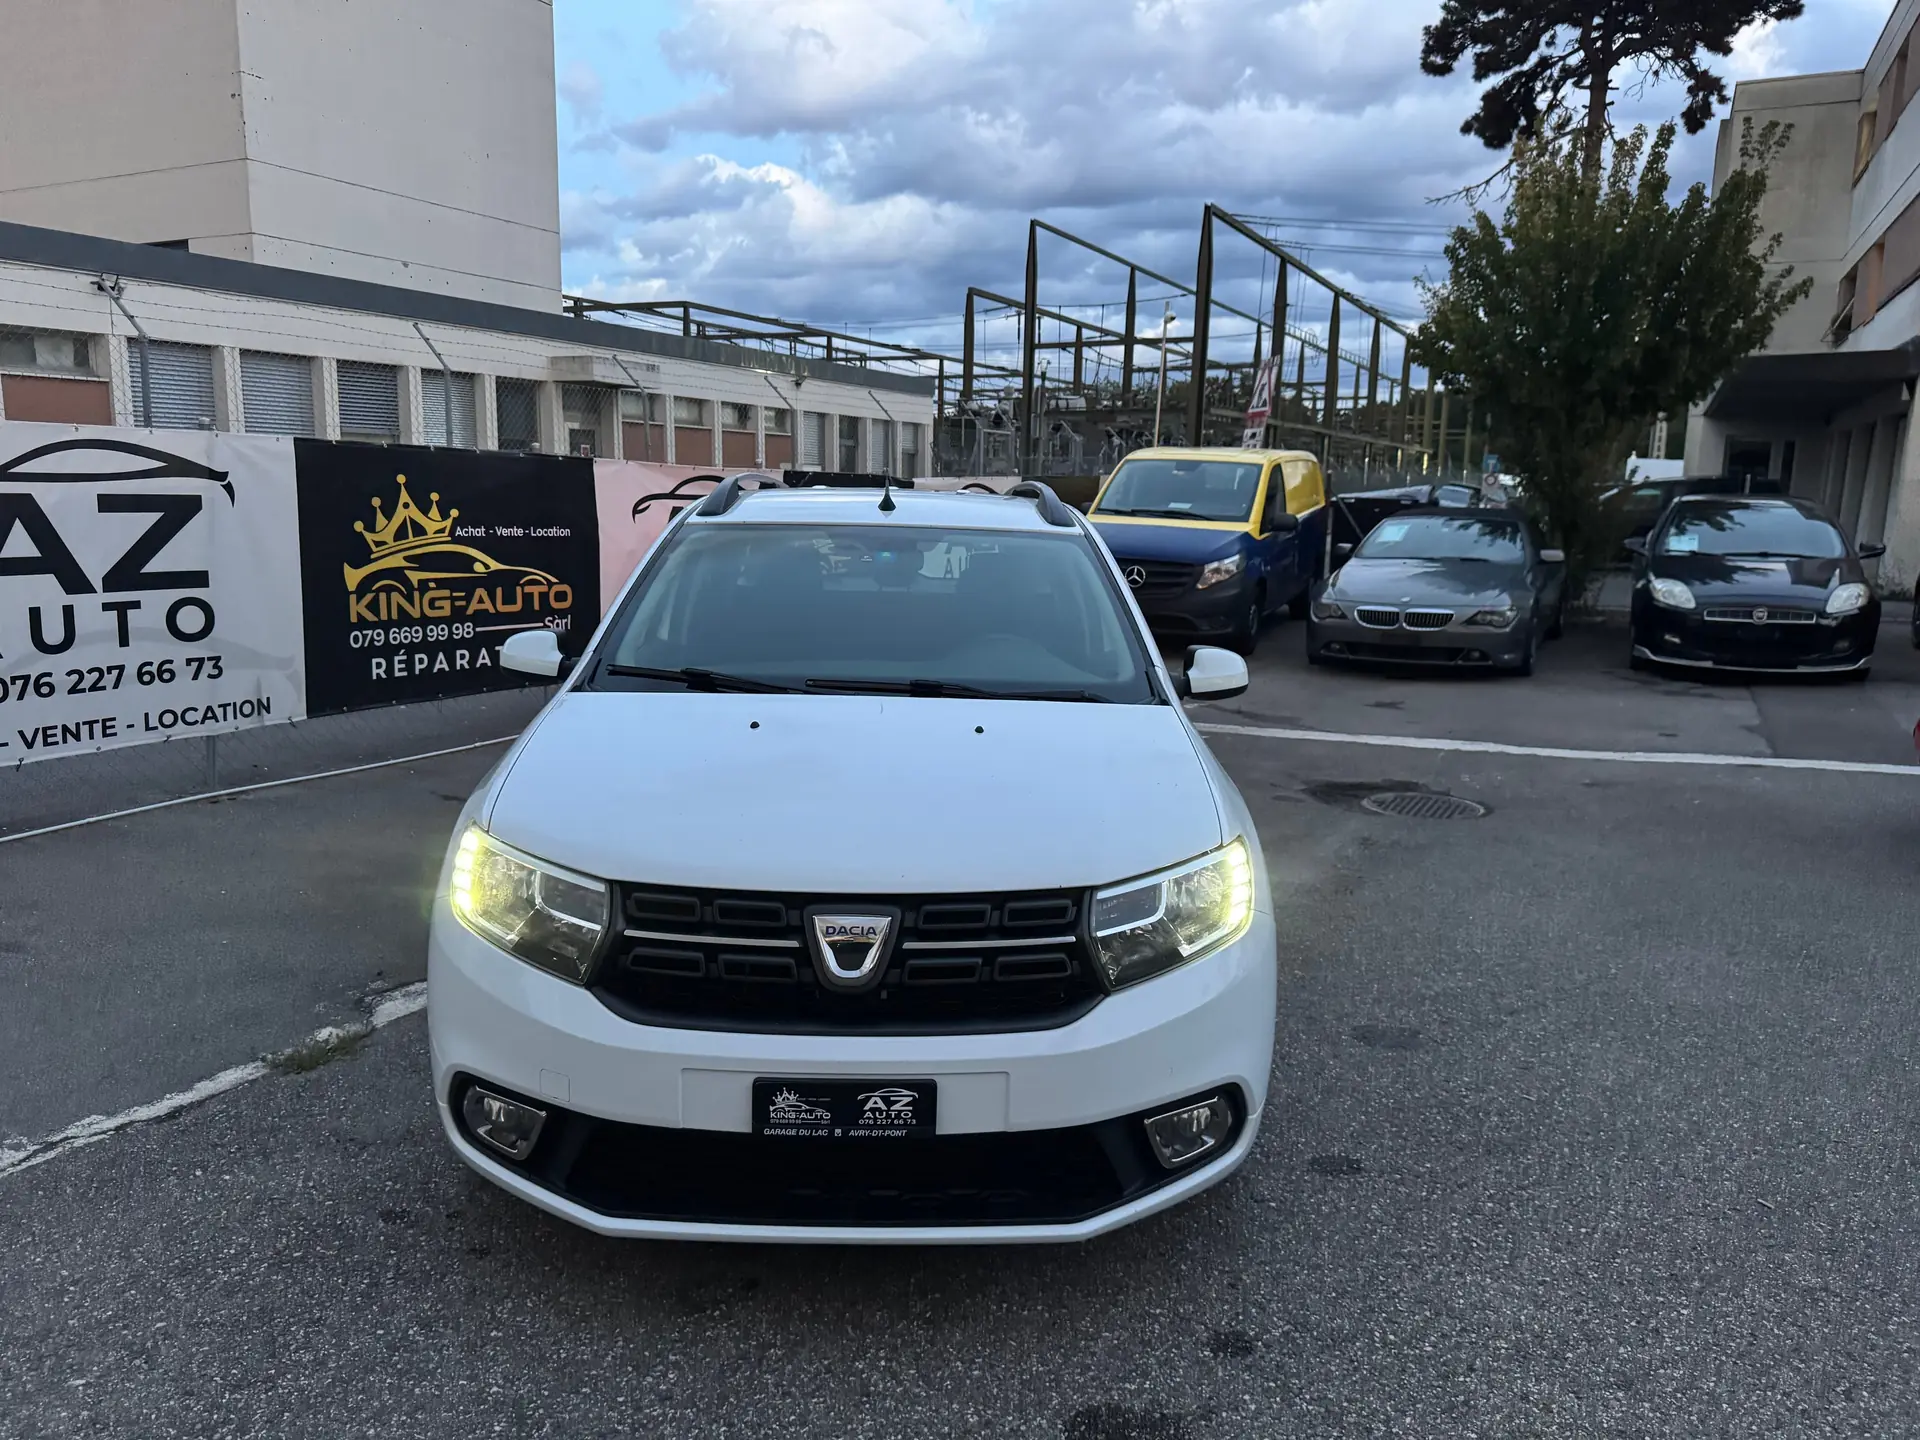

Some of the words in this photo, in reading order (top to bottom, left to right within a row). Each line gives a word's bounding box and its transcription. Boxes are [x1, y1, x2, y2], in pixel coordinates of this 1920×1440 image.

[455, 525, 486, 537] Achat
[495, 526, 524, 537] Vente
[531, 526, 571, 537] Location
[0, 493, 210, 595] AZ
[0, 596, 215, 659] UTO
[544, 614, 571, 631] Sàrl
[349, 629, 385, 648] 079
[389, 626, 423, 644] 669
[426, 624, 449, 642] 99
[452, 622, 474, 639] 98
[372, 646, 503, 680] RÉPARA
[66, 664, 126, 695] 227
[136, 659, 176, 687] 66
[185, 655, 224, 681] 73
[18, 717, 118, 750] VENTE
[144, 697, 272, 732] LOCATION
[825, 925, 877, 936] DACIA
[863, 1096, 913, 1110] AZ
[863, 1111, 912, 1119] AUTO
[763, 1128, 797, 1136] GARAGE
[848, 1129, 907, 1137] AVRY-DT-PONT
